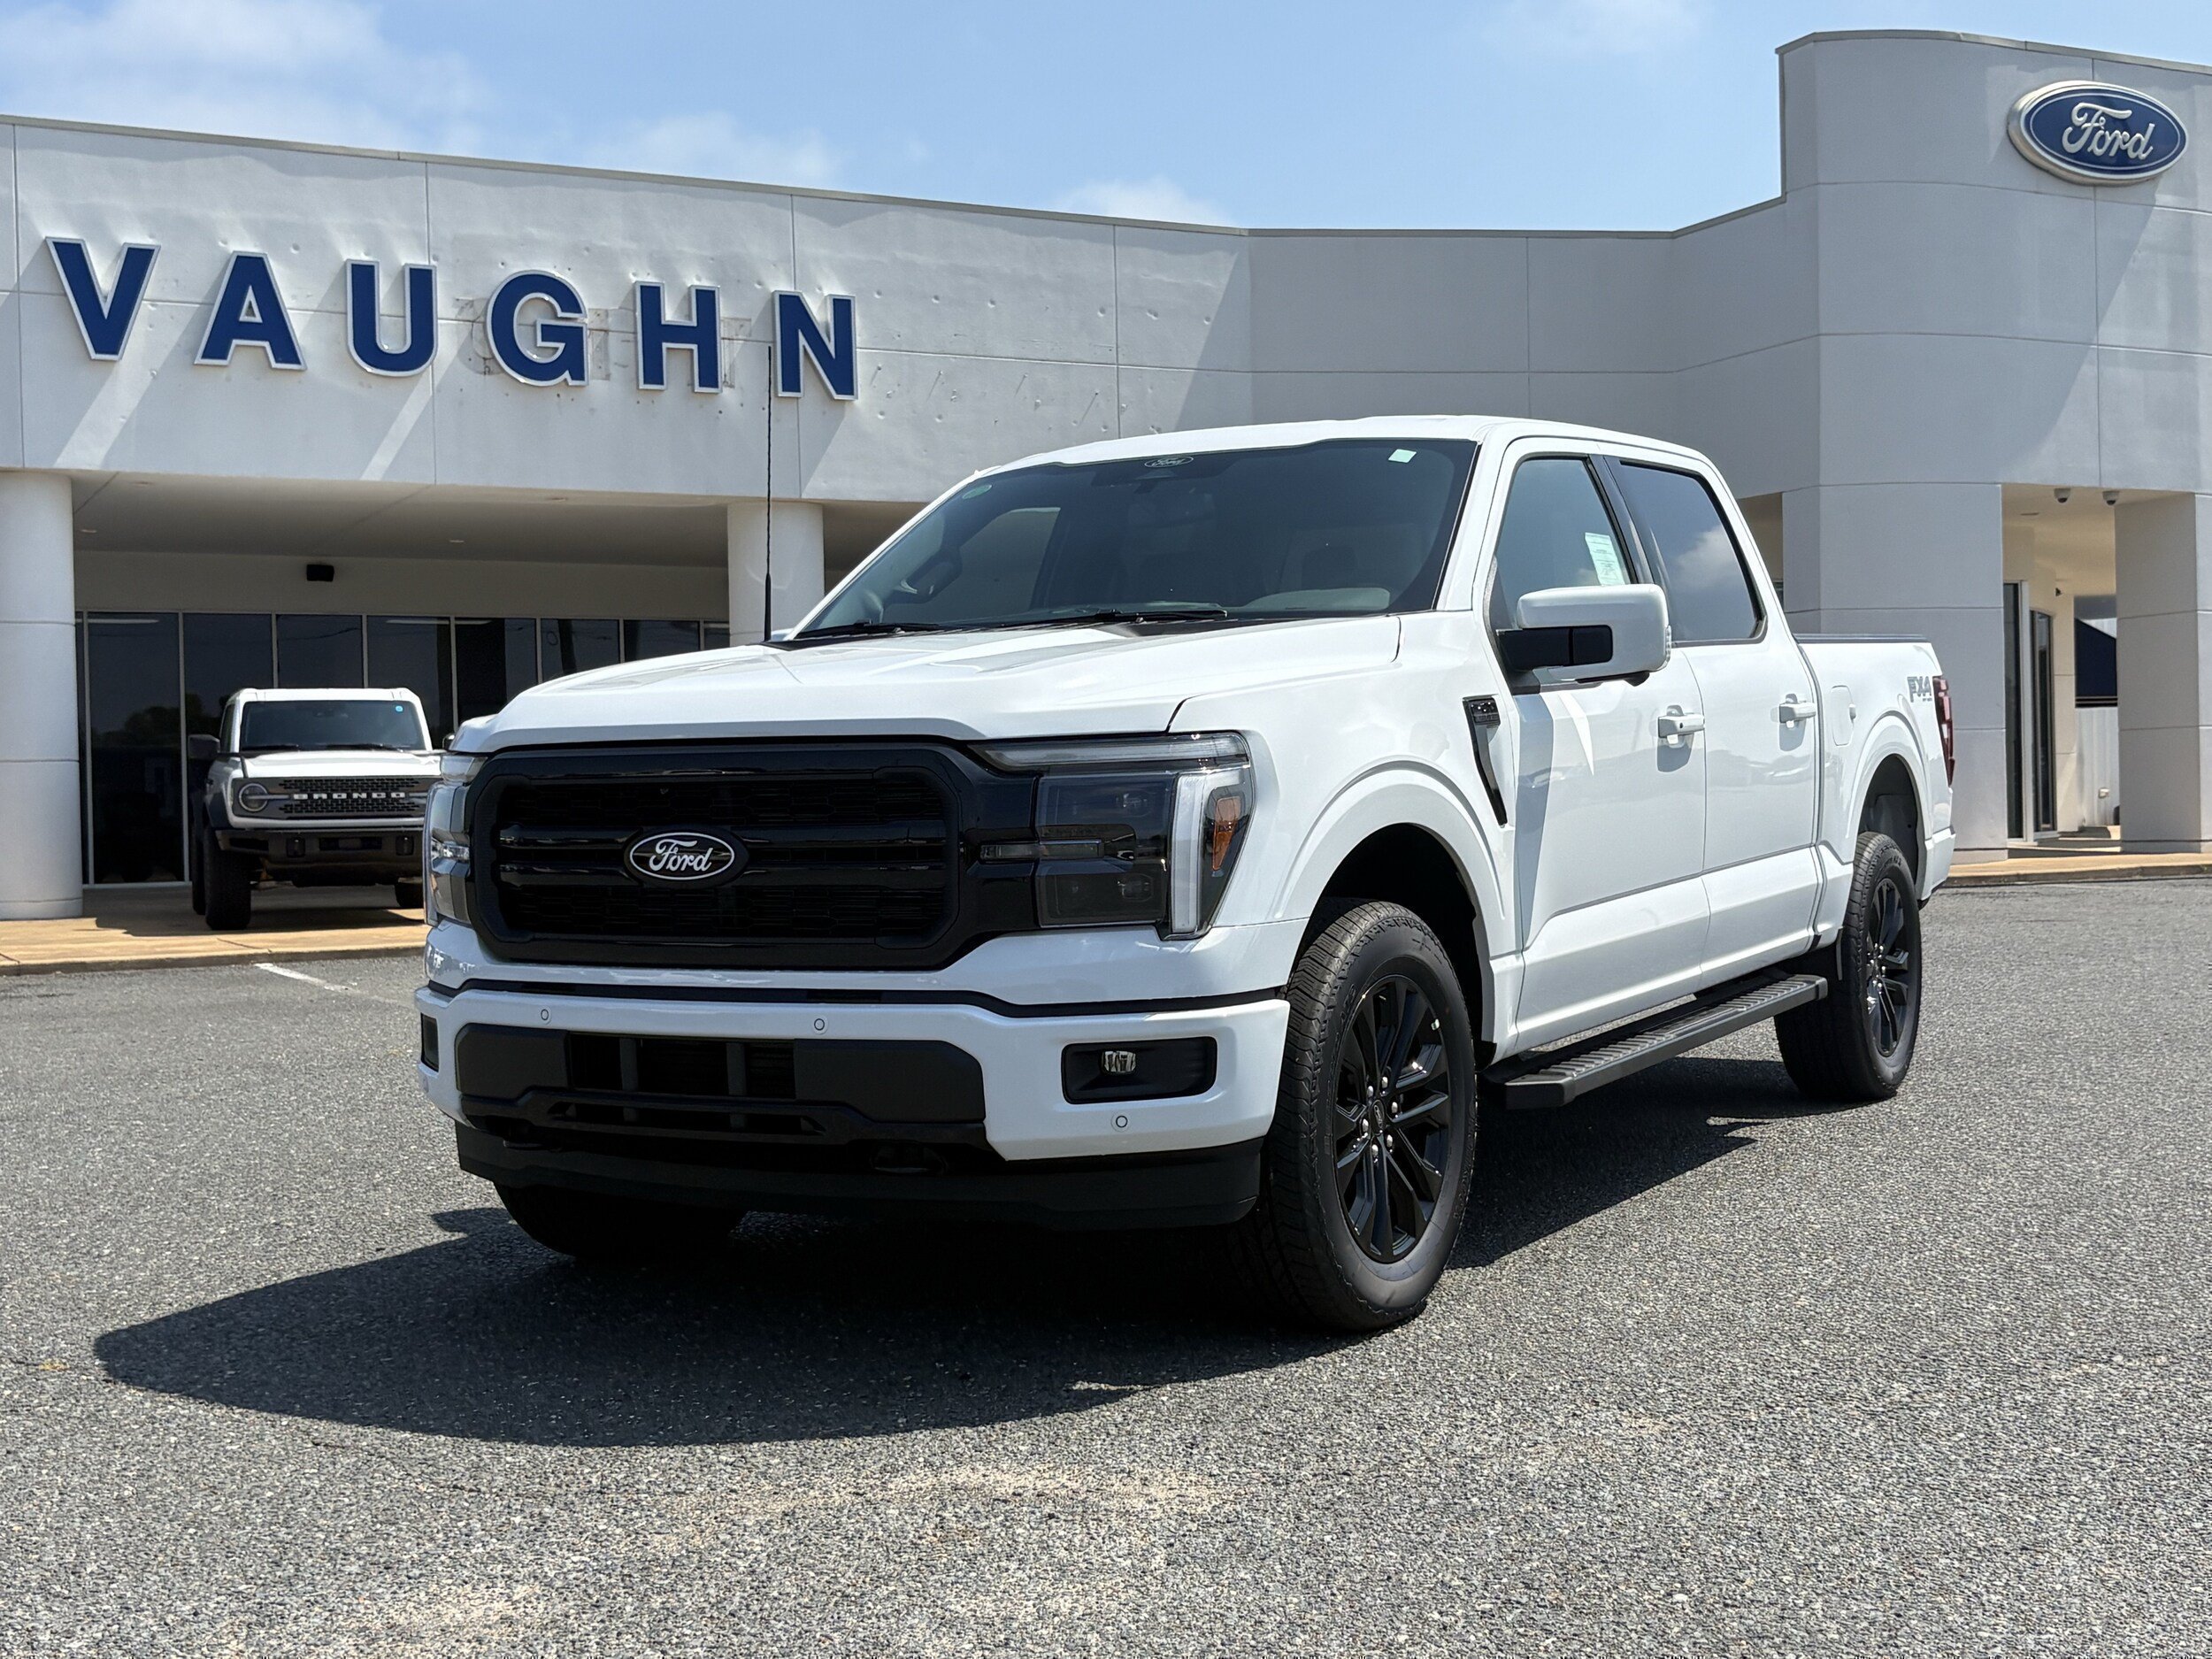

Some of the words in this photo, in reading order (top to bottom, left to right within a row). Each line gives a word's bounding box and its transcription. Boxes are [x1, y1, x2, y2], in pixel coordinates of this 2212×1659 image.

[2062, 102, 2155, 160] Ford
[45, 236, 858, 401] VAUGHN
[649, 839, 714, 872] Ford
